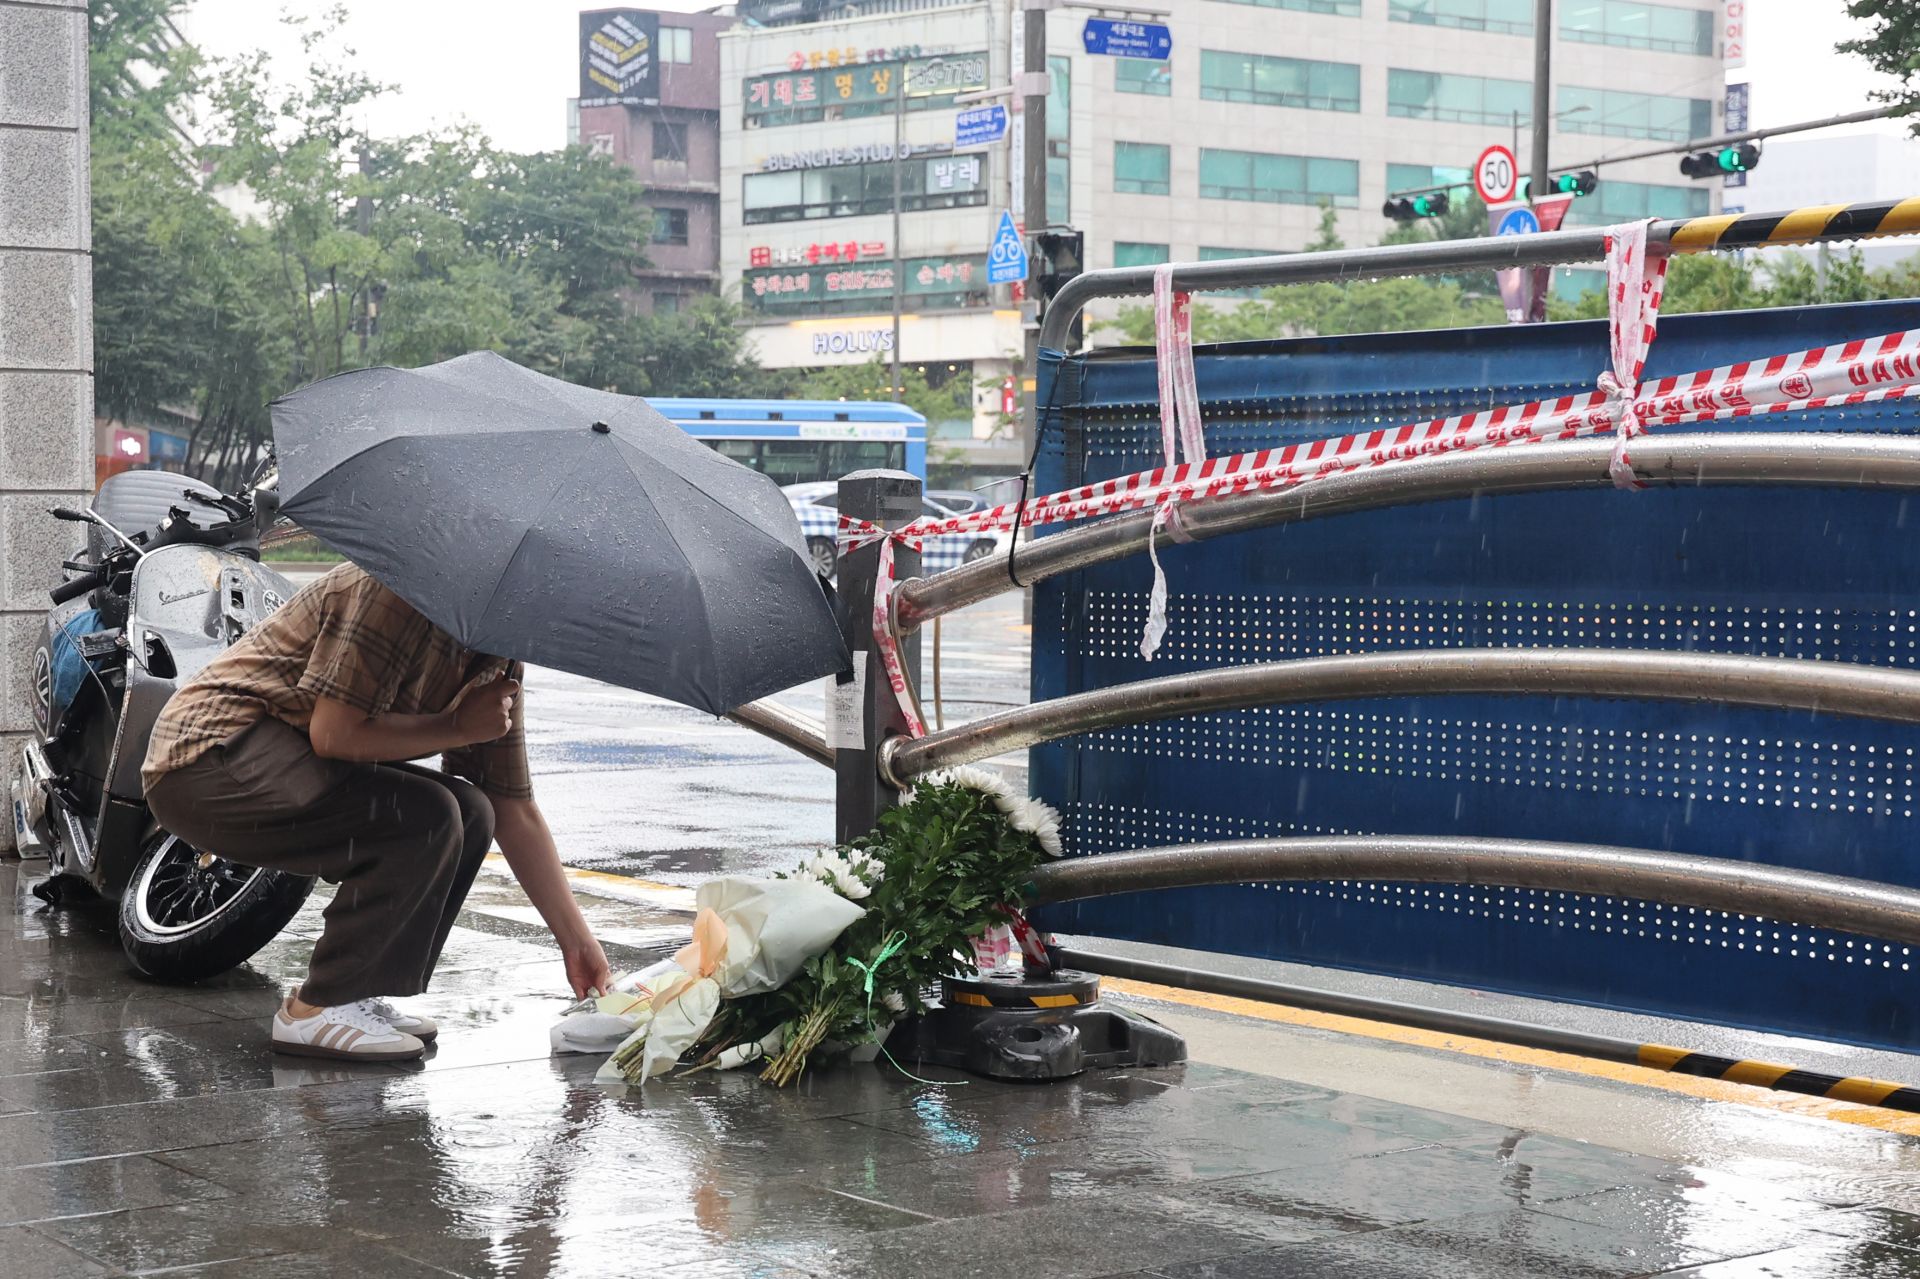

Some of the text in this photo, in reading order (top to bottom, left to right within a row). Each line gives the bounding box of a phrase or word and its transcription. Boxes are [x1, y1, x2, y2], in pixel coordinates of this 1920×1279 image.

[750, 76, 817, 108] 기체조
[767, 142, 910, 171] BLANCHE STUDO
[934, 157, 979, 189] 발레
[1485, 160, 1509, 190] 50
[813, 329, 894, 354] HOLLYS
